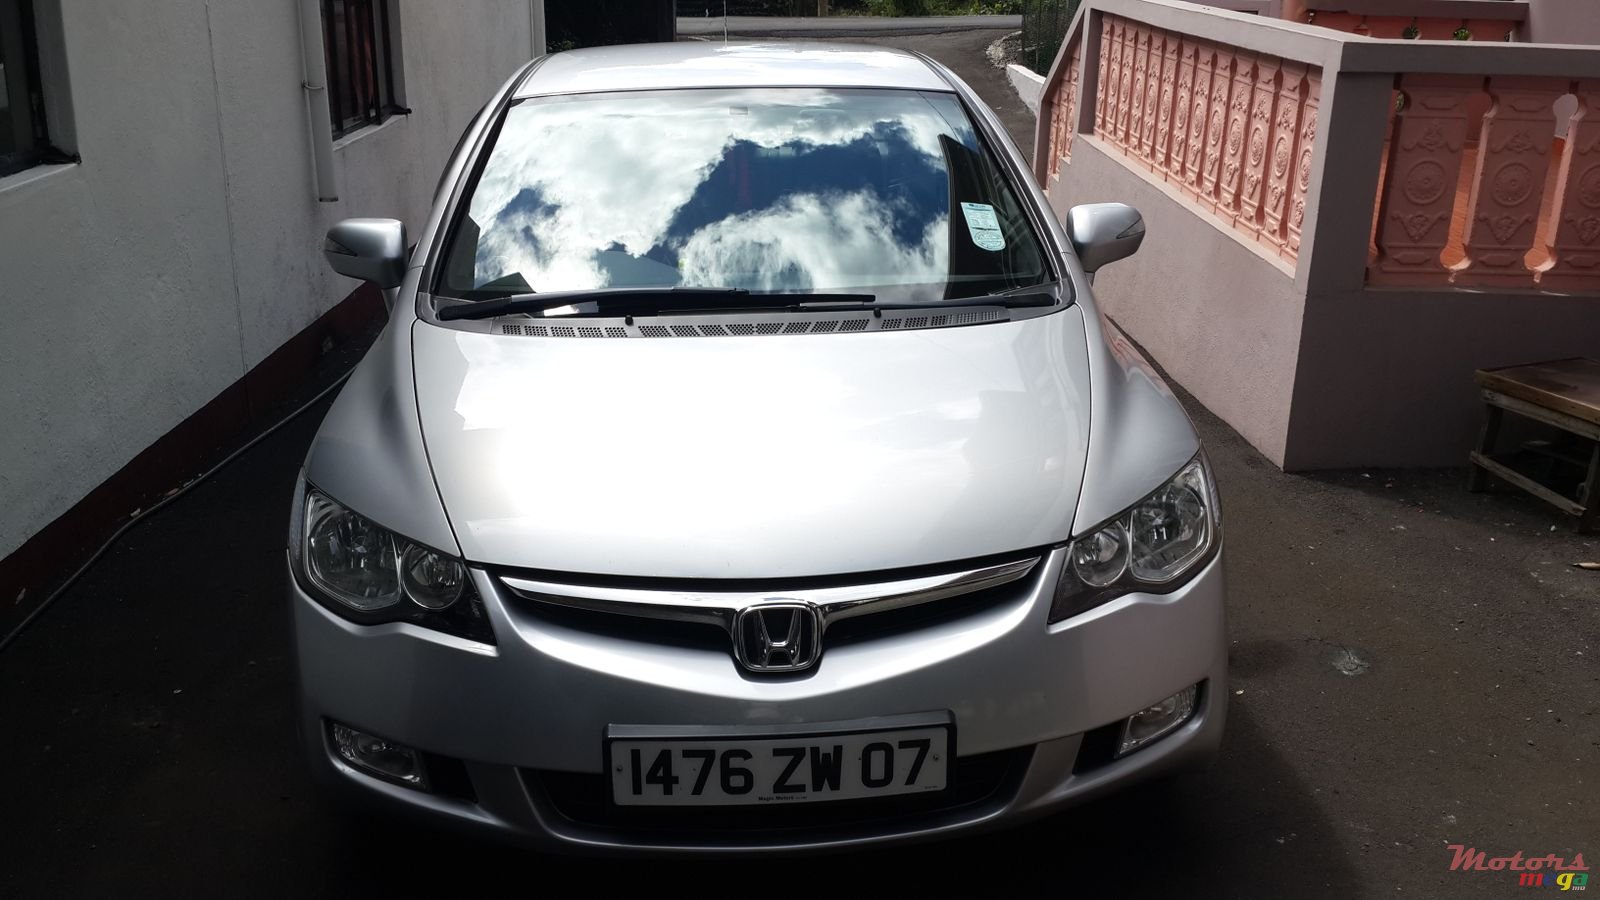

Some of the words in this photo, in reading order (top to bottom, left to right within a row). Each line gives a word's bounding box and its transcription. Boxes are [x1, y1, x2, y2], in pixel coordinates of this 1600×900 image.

[630, 748, 754, 795] 1476
[772, 745, 843, 793] ZW
[861, 738, 931, 788] 07
